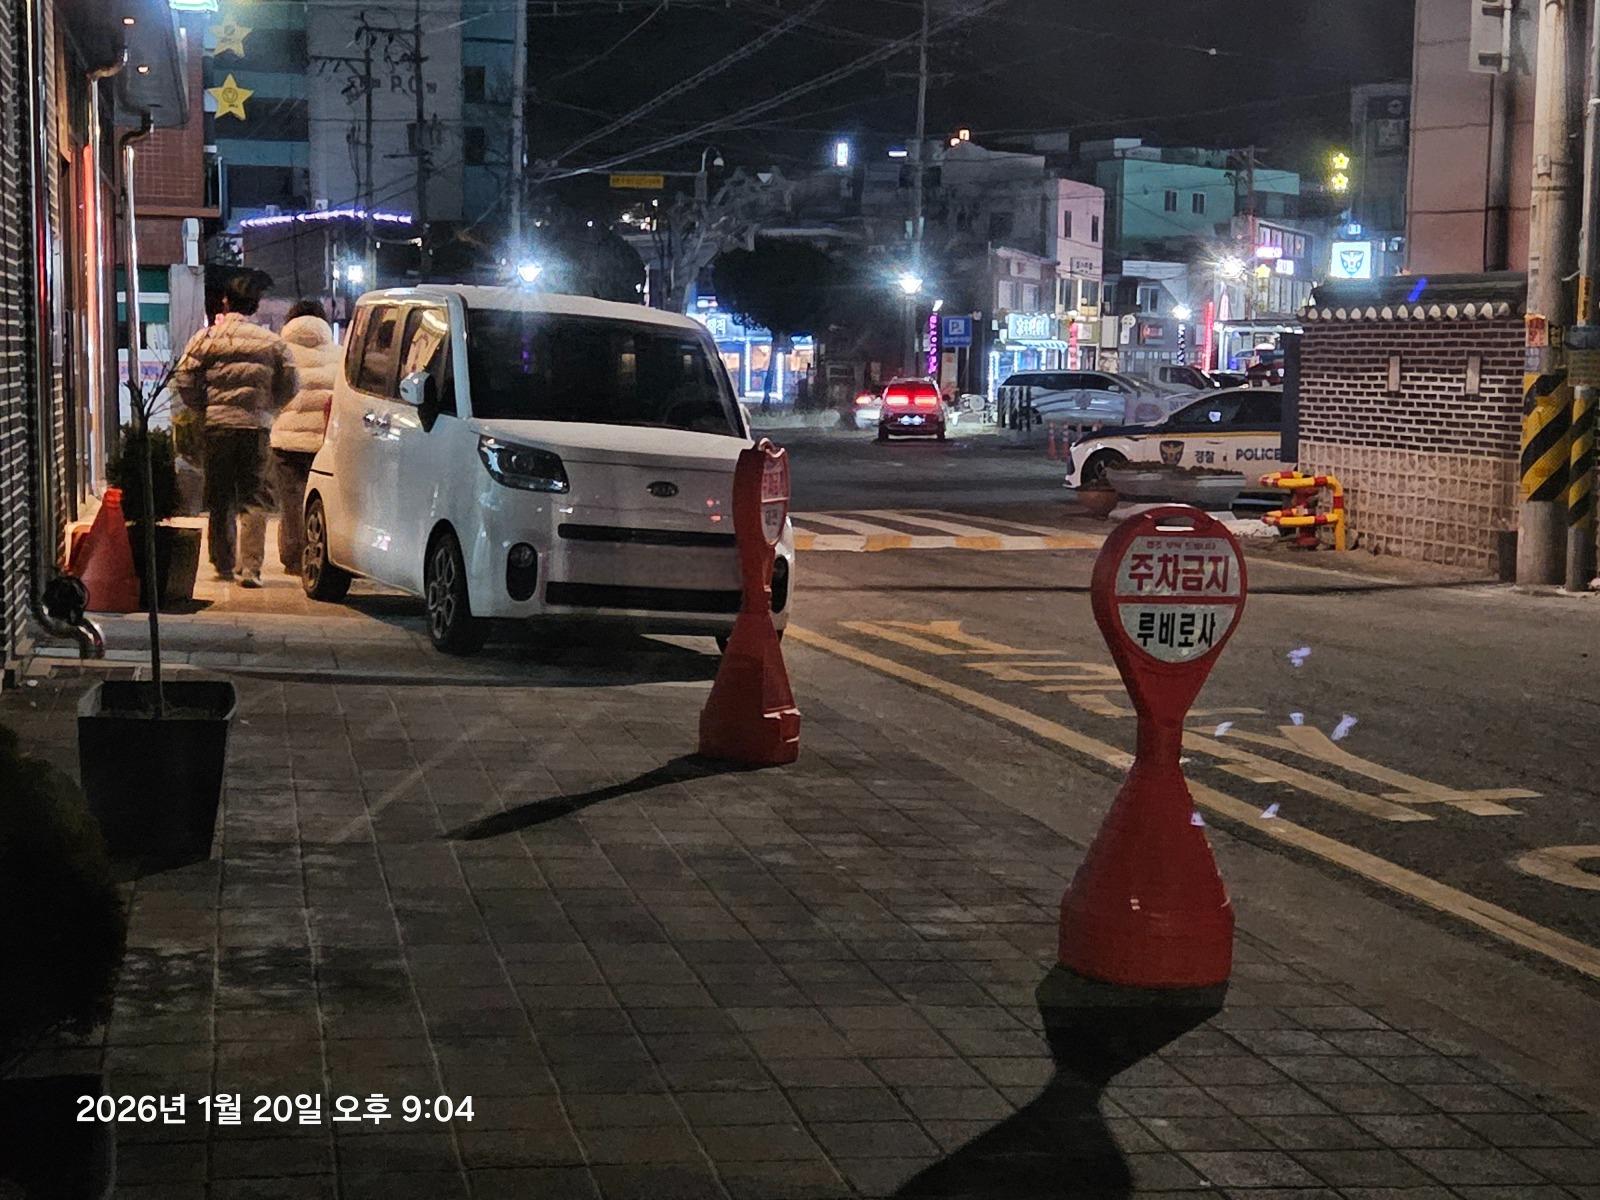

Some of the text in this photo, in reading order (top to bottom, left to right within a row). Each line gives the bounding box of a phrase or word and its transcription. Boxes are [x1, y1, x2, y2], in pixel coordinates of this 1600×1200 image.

[1194, 450, 1215, 464] 경찰
[1235, 448, 1281, 461] POLICE
[1128, 553, 1230, 593] 주차금지
[1137, 612, 1216, 648] 루비로사
